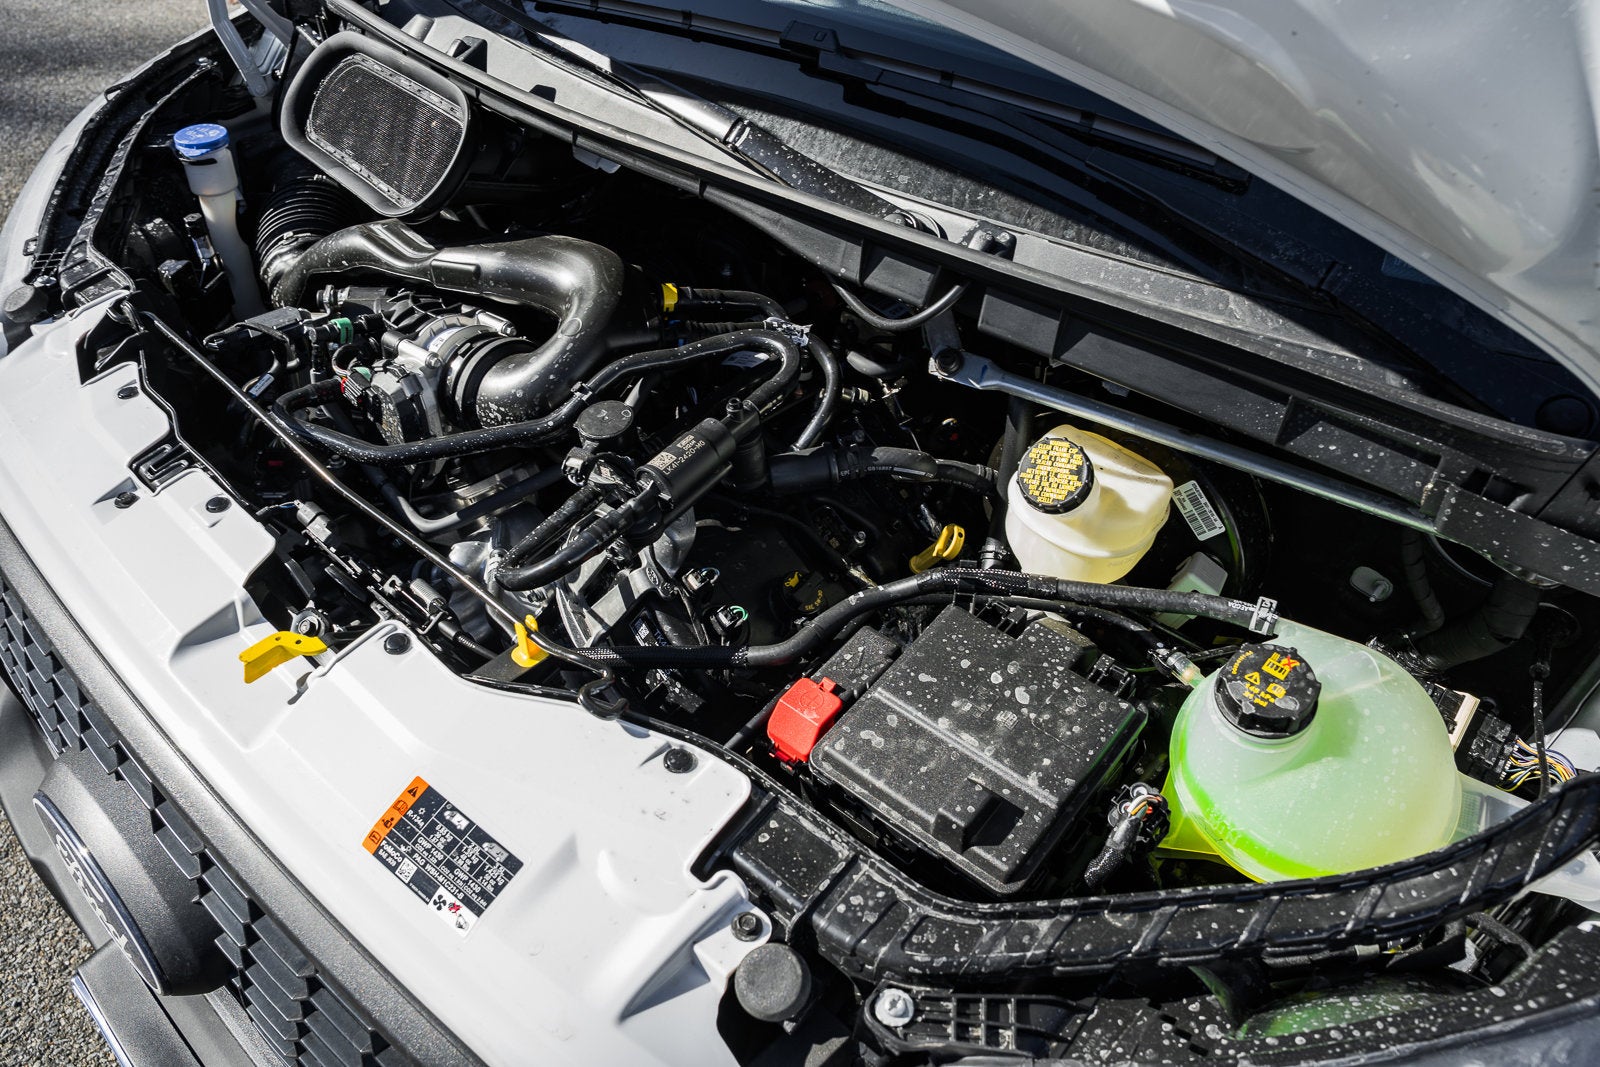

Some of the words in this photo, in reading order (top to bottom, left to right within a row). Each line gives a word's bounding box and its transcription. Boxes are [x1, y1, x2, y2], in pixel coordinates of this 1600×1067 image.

[405, 808, 425, 828] R-134a
[443, 832, 453, 842] kg
[379, 839, 404, 862] FoMoCo
[416, 836, 432, 850] GWP
[429, 847, 444, 860] 1430
[412, 853, 425, 865] PAG
[469, 854, 479, 864] kg
[440, 865, 450, 874] CO2
[482, 865, 498, 879] 1.425
[495, 876, 505, 885] kg
[453, 867, 468, 882] GWP
[466, 879, 481, 893] 1430
[477, 876, 488, 886] 3.14
[463, 885, 473, 894] CO2
